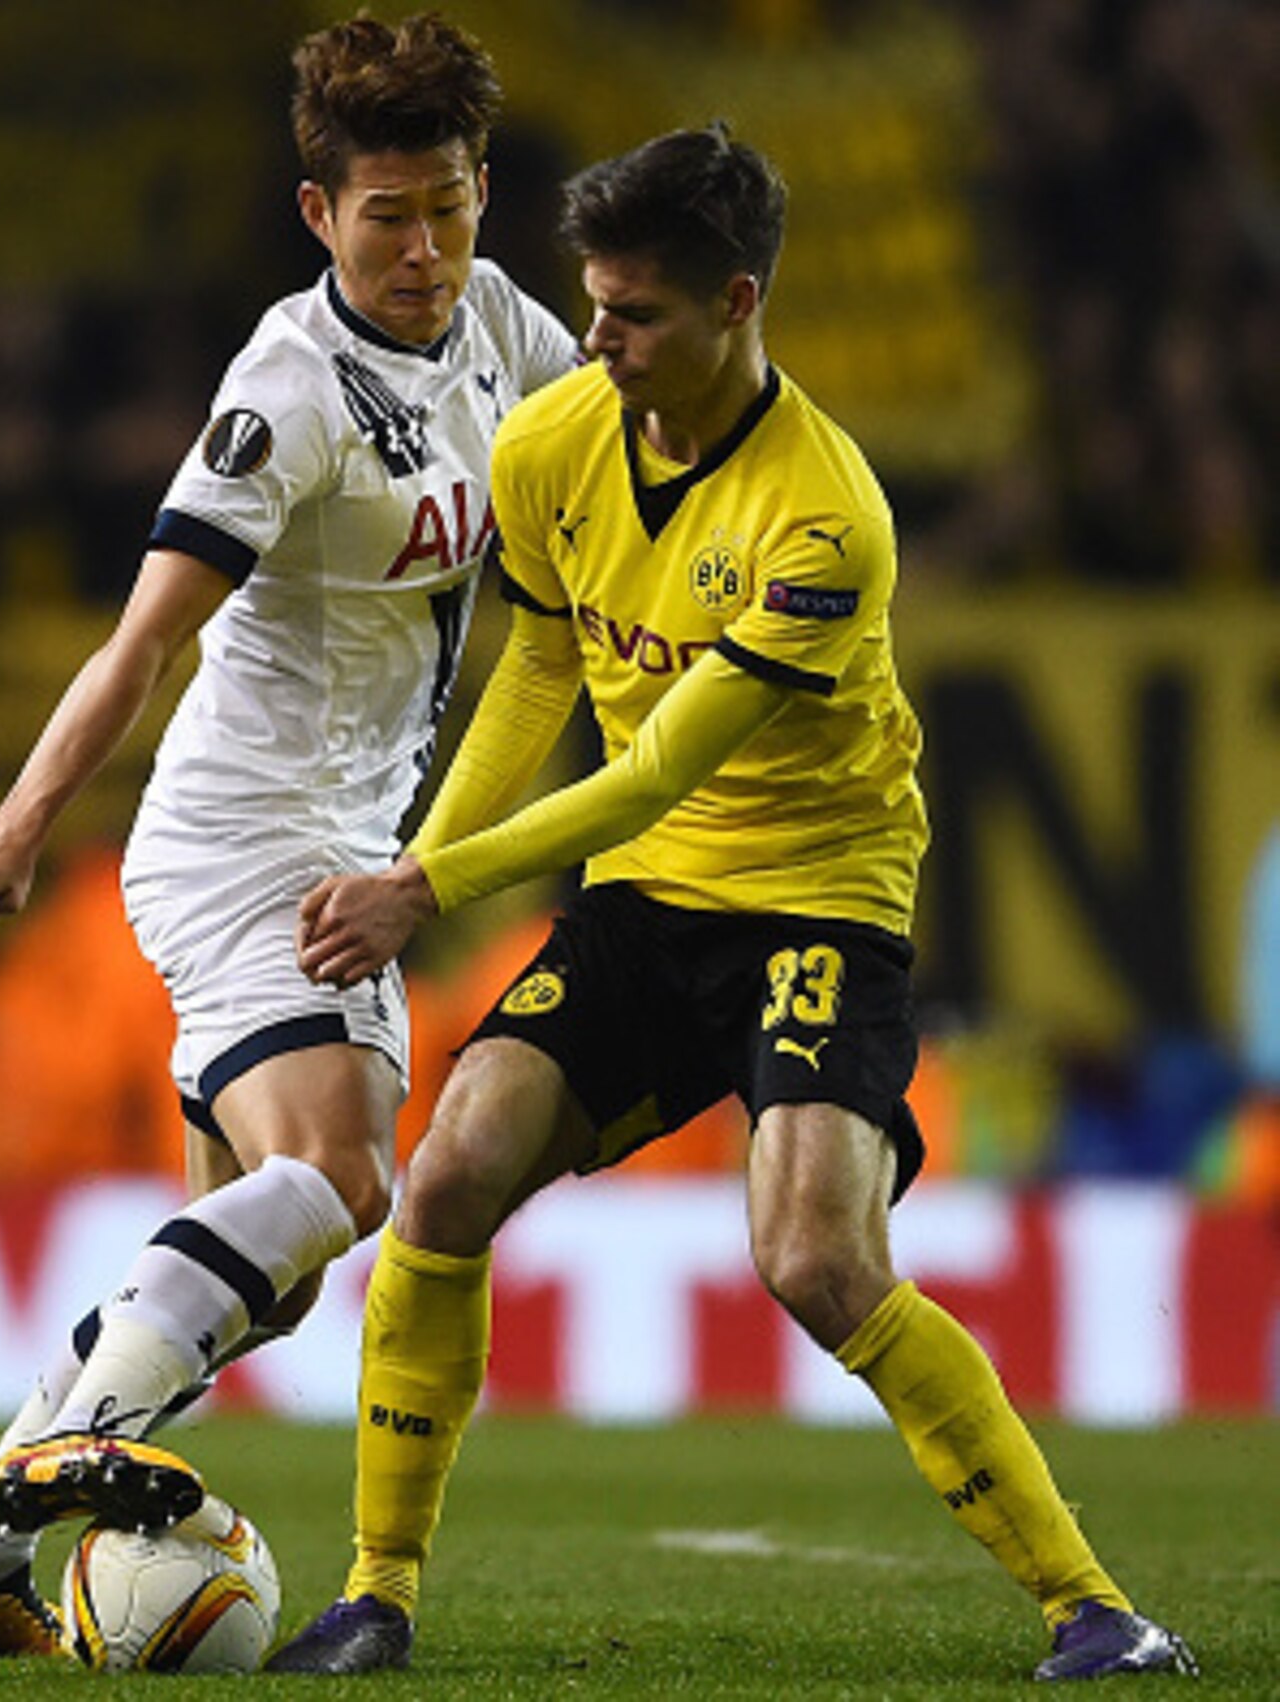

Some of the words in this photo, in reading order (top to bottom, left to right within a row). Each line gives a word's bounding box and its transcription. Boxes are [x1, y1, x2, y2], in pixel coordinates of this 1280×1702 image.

[761, 944, 843, 1031] 33
[370, 1403, 433, 1437] BVB
[943, 1467, 994, 1510] BVB
